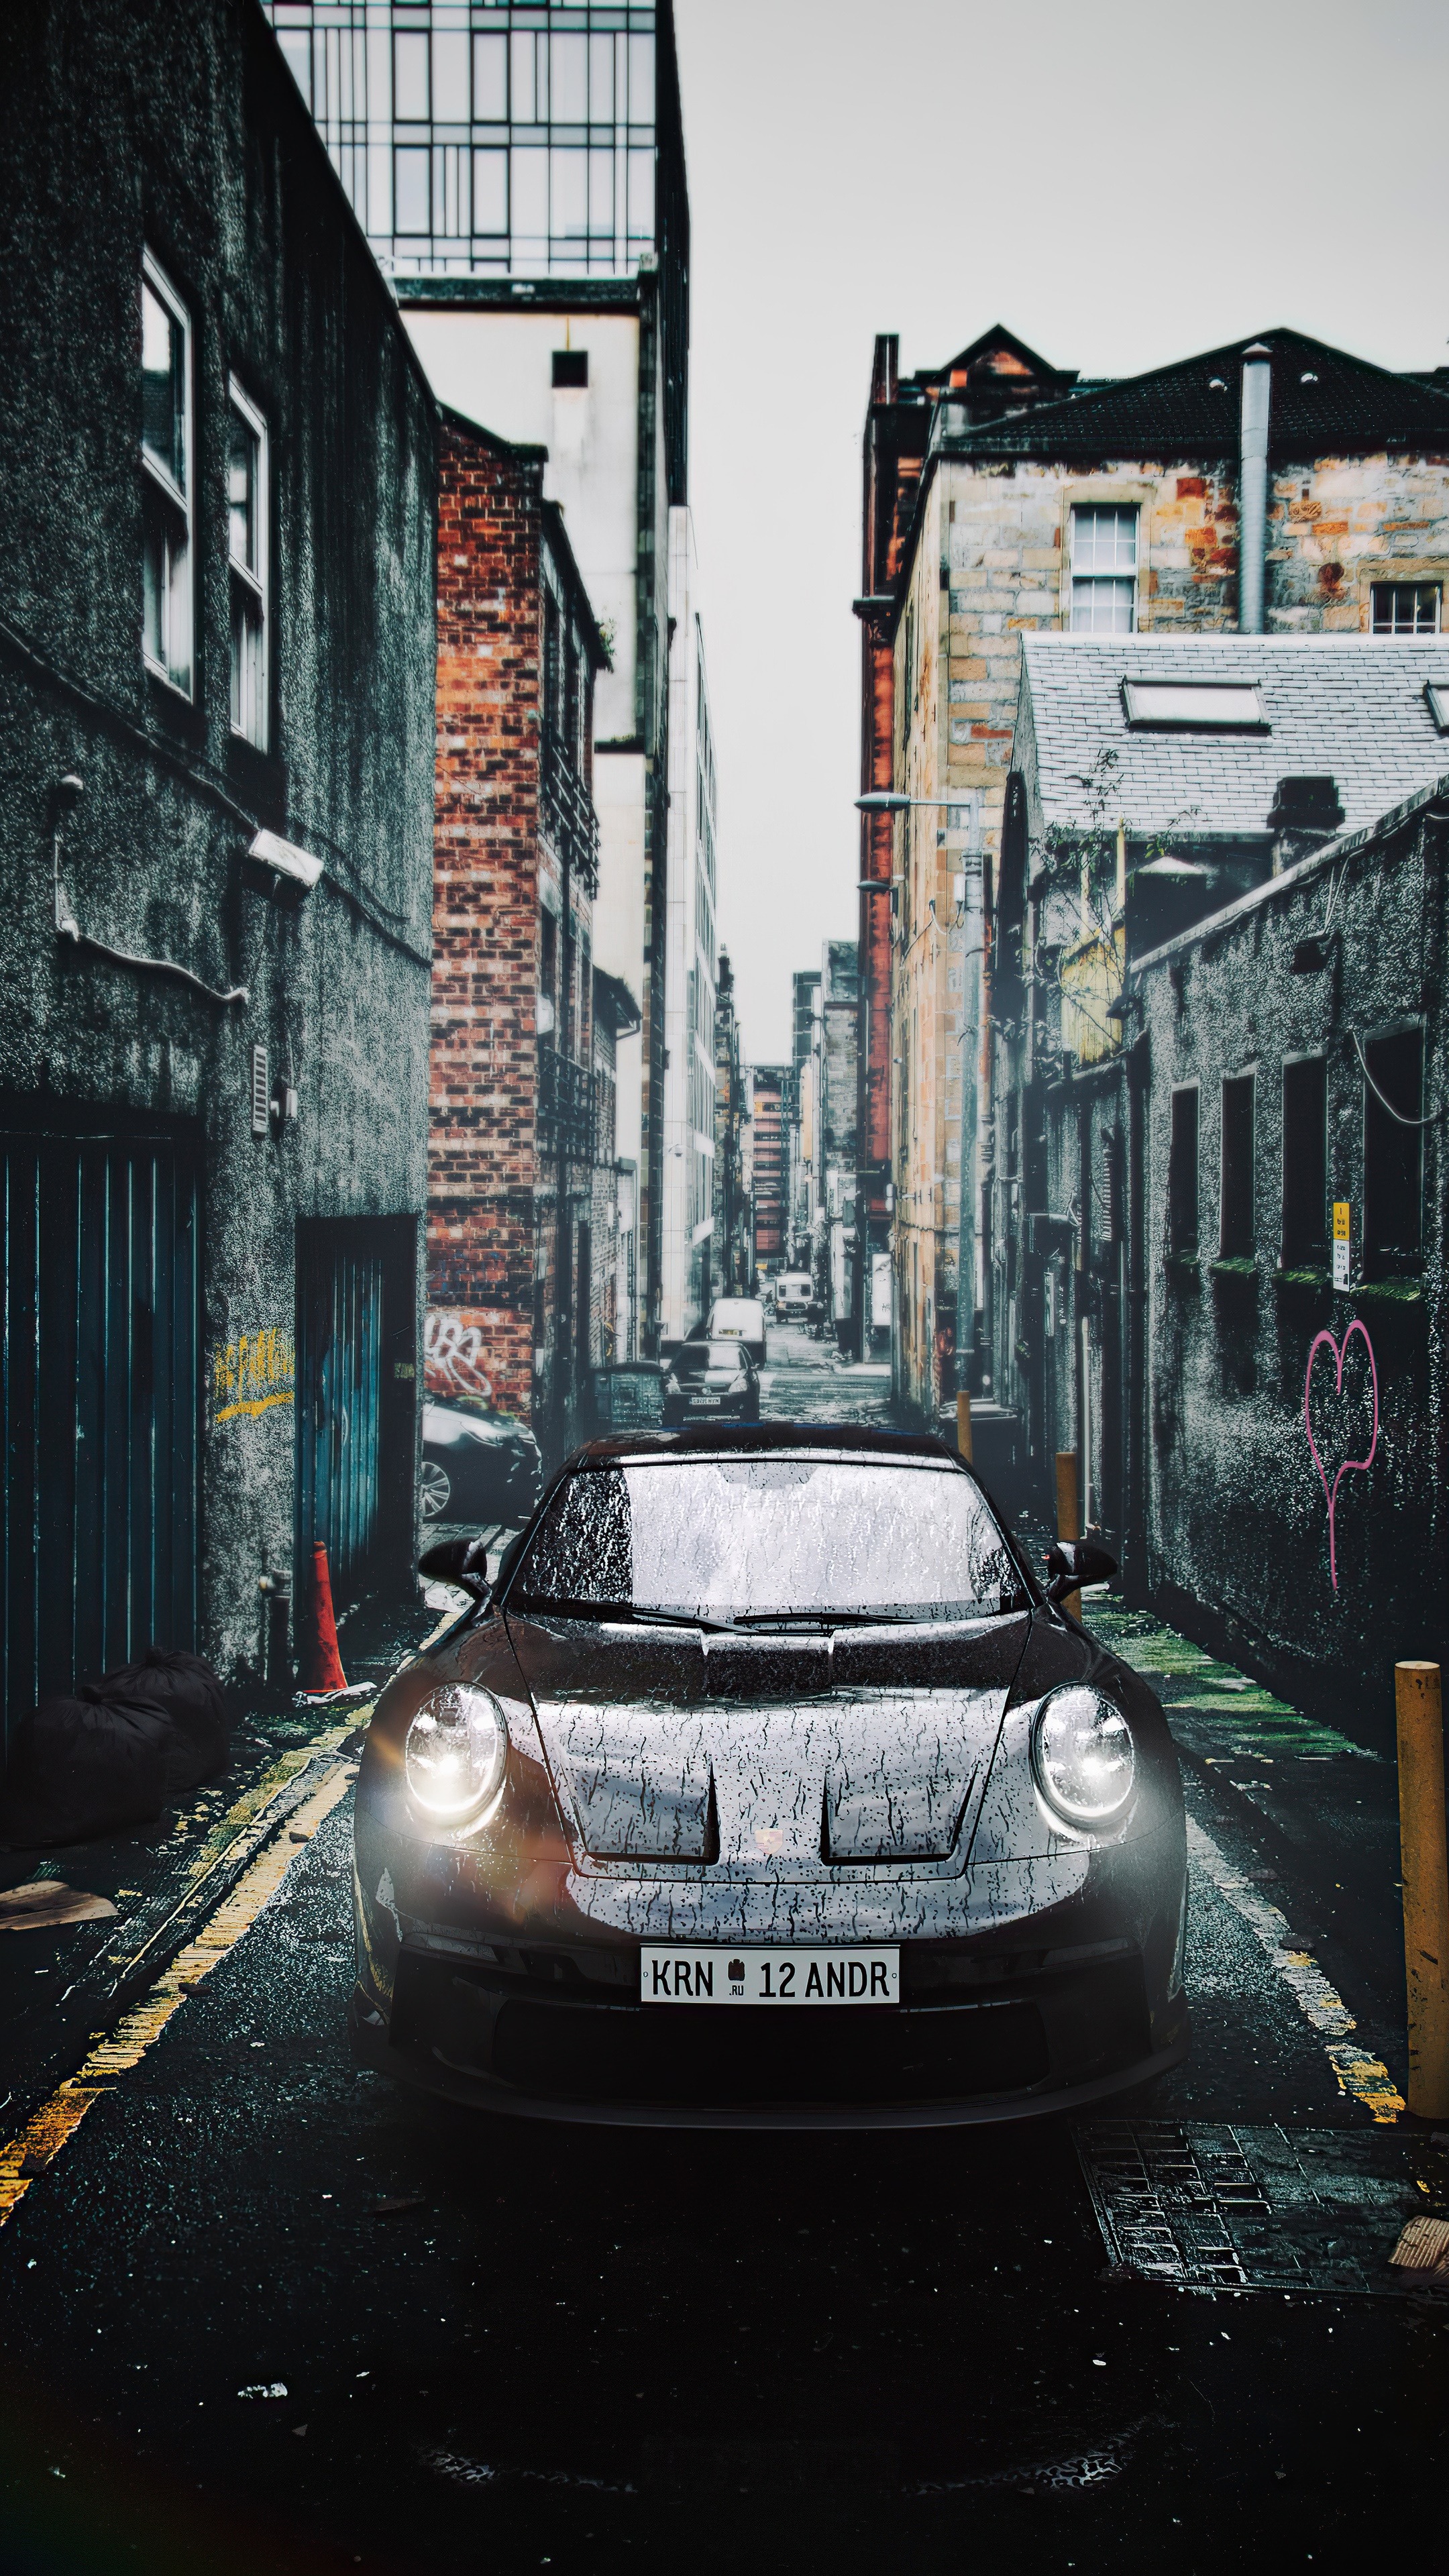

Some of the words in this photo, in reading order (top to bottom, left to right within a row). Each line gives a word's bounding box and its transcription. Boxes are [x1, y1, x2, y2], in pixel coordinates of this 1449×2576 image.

[651, 1960, 713, 1996] KRN
[759, 1962, 796, 1998] 12
[805, 1961, 890, 1998] ANDR
